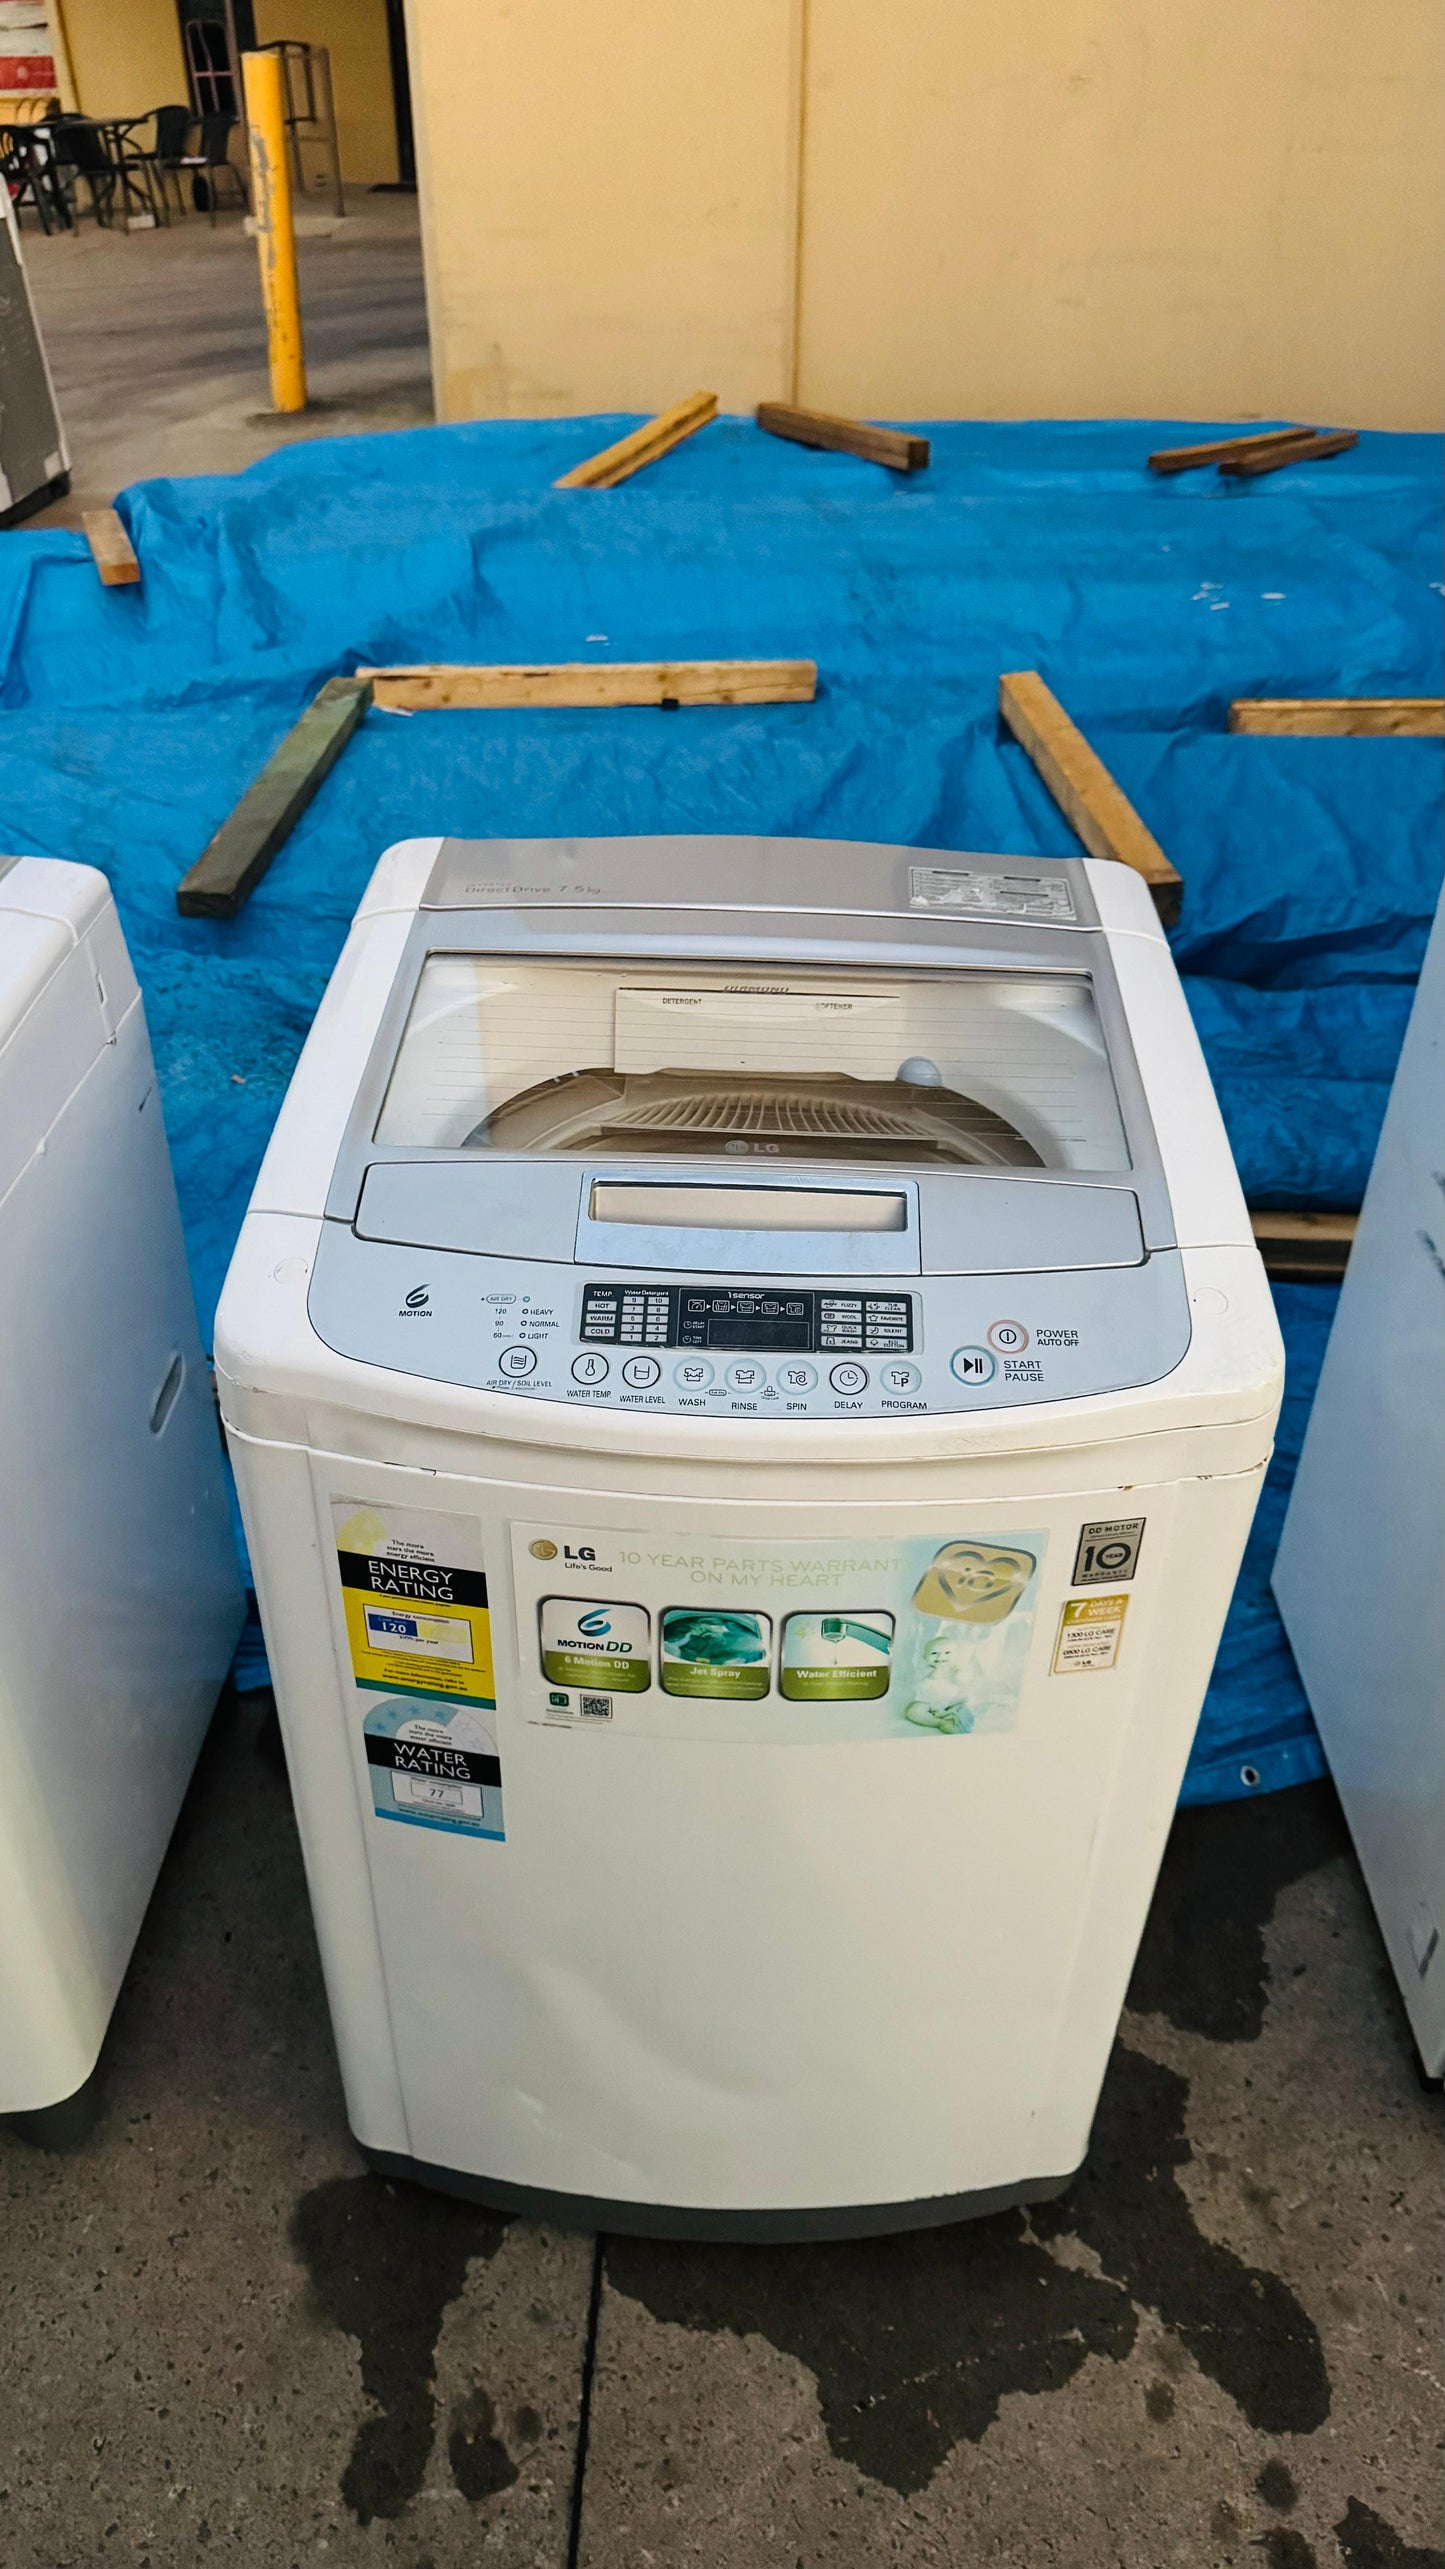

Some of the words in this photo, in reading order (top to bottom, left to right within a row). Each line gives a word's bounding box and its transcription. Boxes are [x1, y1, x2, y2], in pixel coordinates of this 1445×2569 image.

[753, 1143, 779, 1153] LG
[530, 1308, 553, 1316] HEAVY
[529, 1320, 560, 1328] NORMAL
[527, 1332, 549, 1340] LIGHT
[1036, 1329, 1078, 1338] POWER
[1003, 1360, 1041, 1369] START
[1004, 1373, 1044, 1382] PAUSE
[567, 1390, 590, 1398] WATER
[620, 1395, 644, 1403] WATER
[645, 1396, 665, 1404] LEVEL
[731, 1402, 757, 1410] RINSE
[786, 1403, 807, 1411] SPIN
[834, 1401, 863, 1409] DELAY
[881, 1400, 927, 1410] PROGRAM
[1088, 1527, 1102, 1535] DD
[1104, 1522, 1139, 1533] MOTOR
[563, 1545, 596, 1561] LG
[1084, 1542, 1132, 1572] 10
[618, 1551, 641, 1564] 10
[647, 1553, 704, 1570] YEAR
[713, 1557, 784, 1573] PARTS
[368, 1560, 453, 1585] ENERGY
[564, 1562, 587, 1571] Life's
[588, 1564, 613, 1573] Good
[690, 1570, 723, 1585] ON
[731, 1573, 763, 1586] MY
[770, 1574, 844, 1588] HEART
[371, 1576, 454, 1601] RATING
[1070, 1602, 1088, 1618] 7
[382, 1621, 407, 1634] 120
[557, 1639, 604, 1651] MOTION
[606, 1641, 633, 1653] DD
[574, 1656, 611, 1668] Motion
[614, 1660, 630, 1670] DD
[690, 1667, 708, 1676] Jet
[710, 1667, 741, 1679] Spray
[797, 1669, 831, 1679] Water
[832, 1669, 877, 1679] Efficient
[394, 1742, 467, 1767] WATER
[394, 1755, 471, 1780] RATING
[430, 1788, 444, 1798] 77
